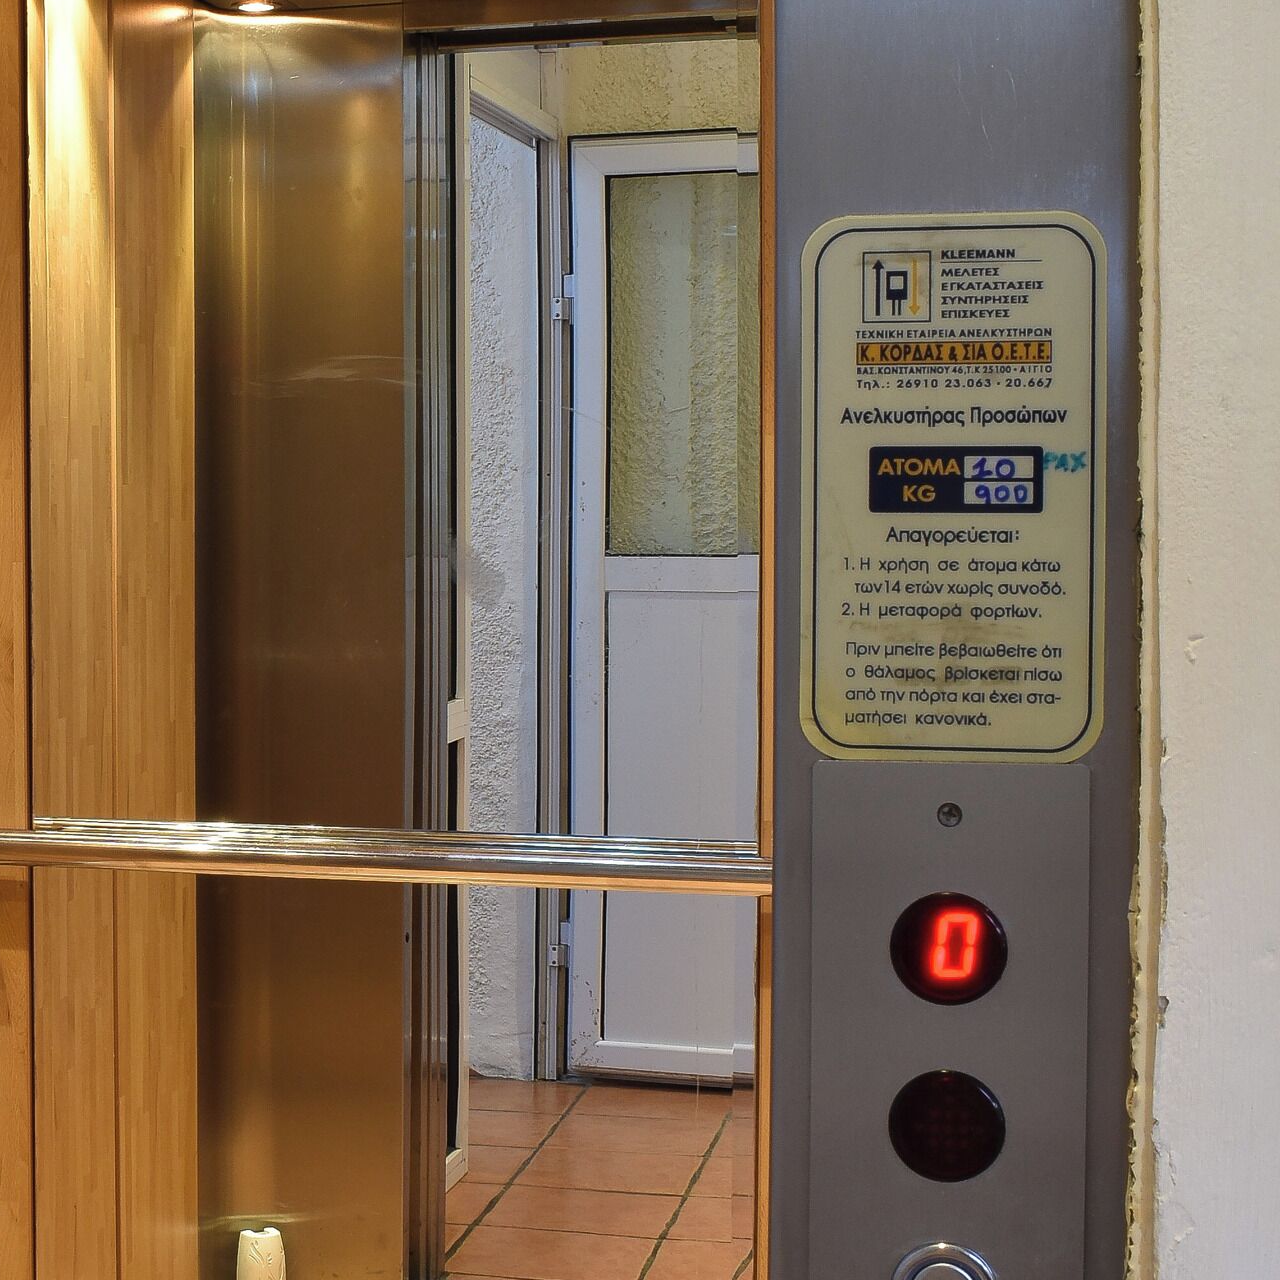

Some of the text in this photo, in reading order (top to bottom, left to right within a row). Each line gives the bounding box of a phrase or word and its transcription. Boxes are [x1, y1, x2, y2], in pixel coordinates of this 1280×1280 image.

[941, 249, 1015, 259] KLEEMANN
[941, 268, 999, 277] ΜΕΛΕΤΕΣ
[942, 281, 1043, 291] ΕΓΚΑΤΑΣΤΑΣΕΙΣ
[941, 295, 1028, 305] ΣΥΝΤΗΡΗΣΕΙΣ
[941, 309, 1010, 318] ΕΠΙΣΚΕΥΕΣ
[856, 328, 1052, 338] ΤΕΧΝΙΚΗ ΕΤΑΙΡΕΙΑ ΑΝΕΛΚΥΣΤΗΡΩΝ
[879, 344, 944, 362] ΚΟΡΔΑΣ
[948, 346, 958, 362] &
[961, 343, 988, 361] ΣΙΑ
[1020, 365, 1052, 373] ΑΙΓΙΟ
[897, 379, 938, 388] 26910
[945, 379, 991, 388] 23.063
[841, 405, 1067, 427] Ανελκυστήρας Προσώπων
[877, 458, 961, 476] ΑΤΟΜΑ
[972, 457, 1016, 479] 10
[902, 485, 1028, 504] KG 900
[844, 557, 1060, 574] 1. Η χρήση σε άτομα κάτω
[905, 581, 944, 594] ετών
[947, 581, 993, 597] χωρίς
[998, 581, 1066, 595] συνοδό.
[842, 603, 1041, 620] 2. Η μεταφορά φορτίων.
[846, 642, 1061, 659] Πριν μπείτε βεβαιωθείτε ότι
[865, 665, 936, 682] θάλαμος
[945, 666, 1020, 683] βρίσκεται
[1024, 668, 1062, 681] πίσω
[846, 688, 876, 700] από
[880, 691, 905, 704] την
[910, 689, 957, 705] πόρτα
[962, 692, 985, 703] και
[989, 690, 1022, 703] έχει
[845, 711, 991, 726] ματήσει κανονικά.
[931, 911, 979, 979] 0
